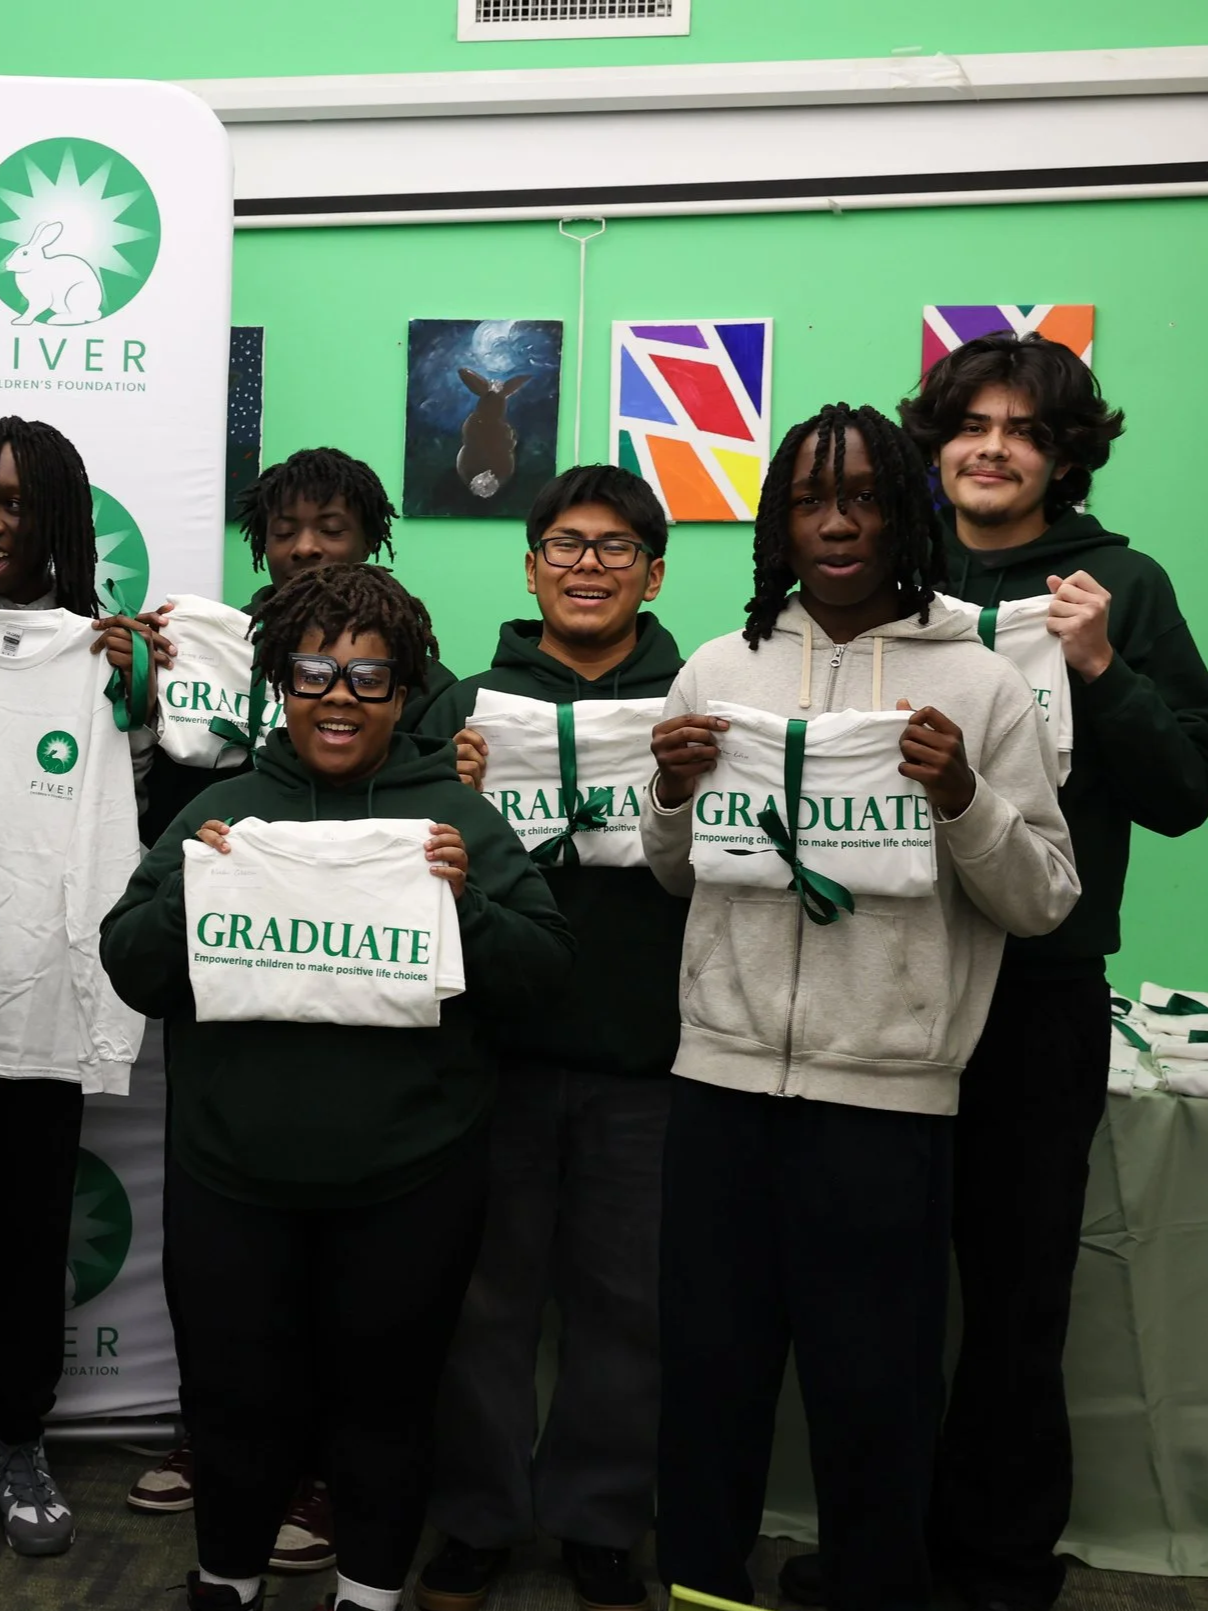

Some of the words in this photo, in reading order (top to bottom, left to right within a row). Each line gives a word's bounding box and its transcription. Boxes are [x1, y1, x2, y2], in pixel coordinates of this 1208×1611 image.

[57, 380, 146, 392] FOUNDATION
[168, 713, 212, 727] mpowering
[30, 780, 74, 796] FIVER
[527, 826, 564, 836] children
[603, 823, 637, 834] positive
[694, 832, 754, 845] Empowering
[798, 839, 809, 847] to
[812, 839, 838, 848] make
[840, 839, 881, 849] positive
[883, 838, 899, 847] life
[196, 911, 432, 965] GRADUATE
[194, 952, 253, 968] Empowering
[255, 958, 294, 970] children
[296, 962, 306, 971] to
[307, 963, 334, 973] make
[336, 965, 374, 977] positive
[376, 967, 391, 979] life
[393, 970, 428, 981] choices
[62, 1366, 120, 1376] NDATION
